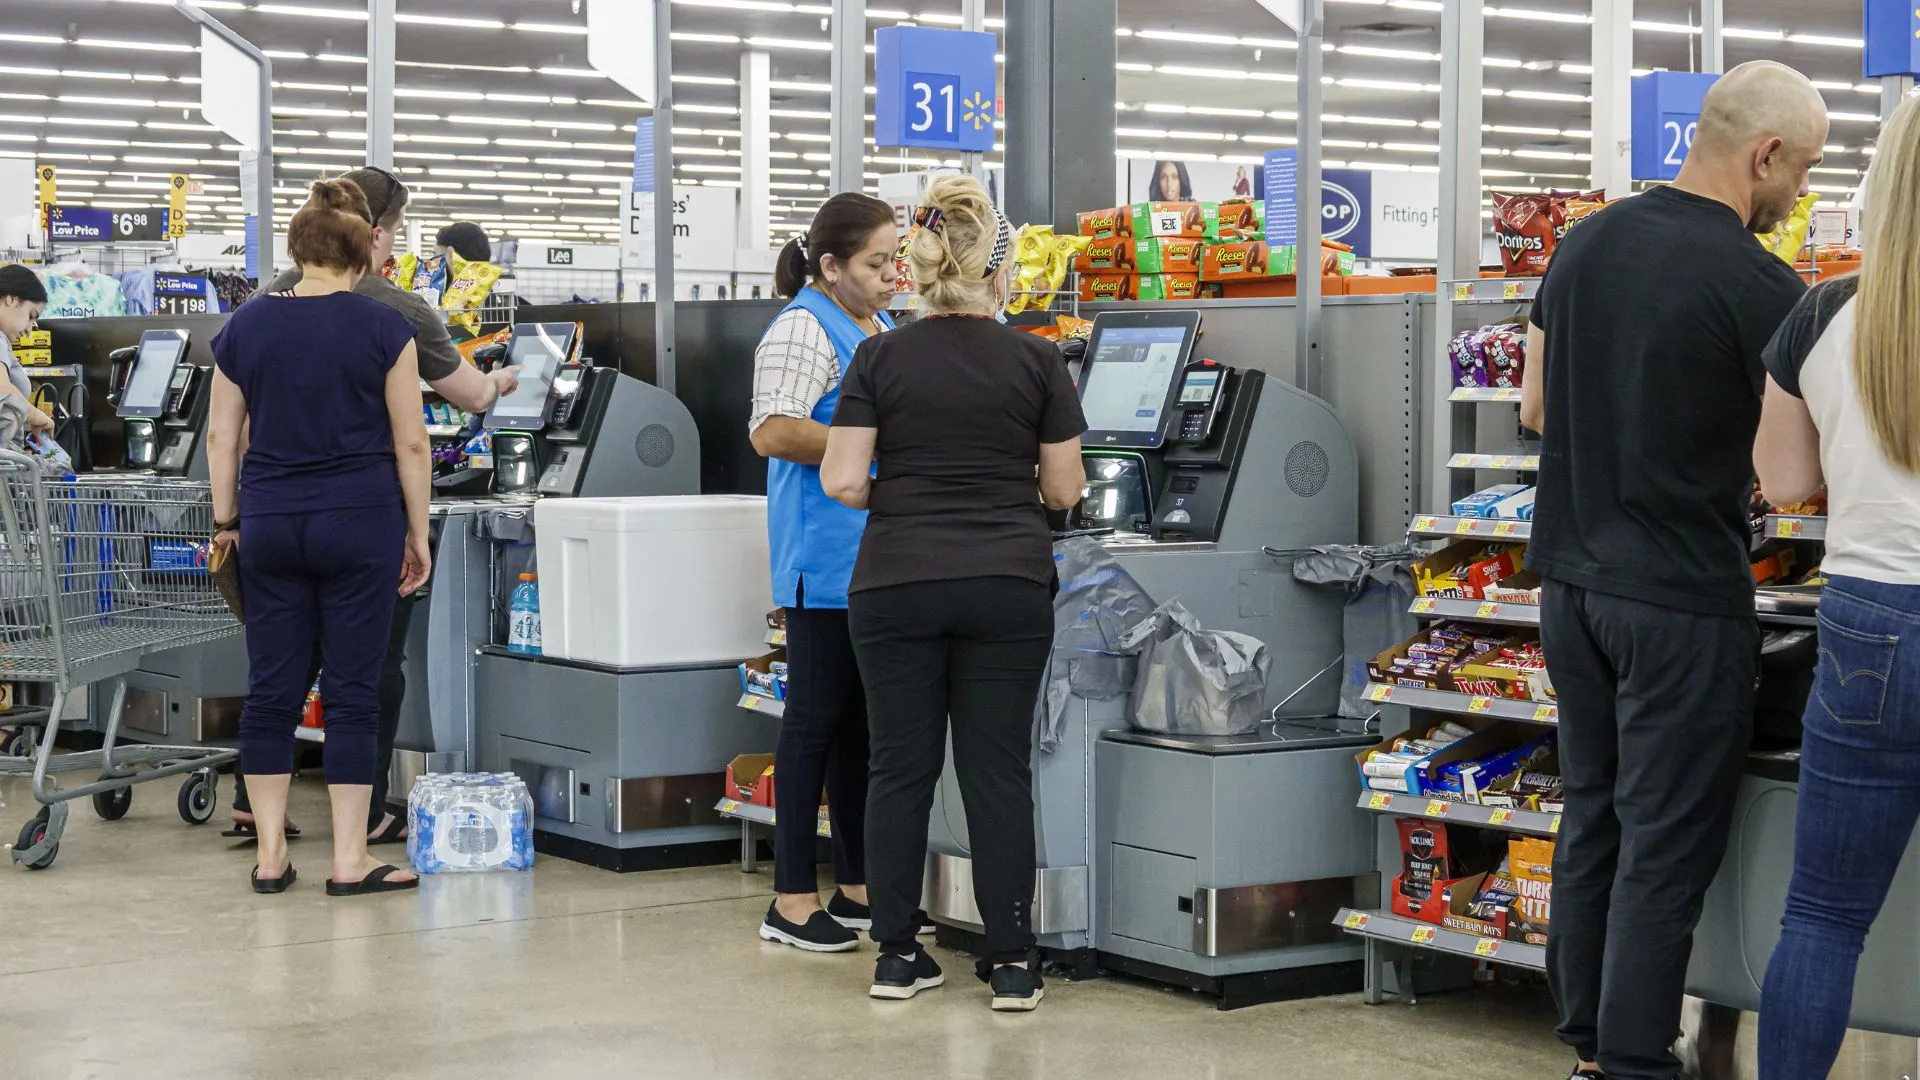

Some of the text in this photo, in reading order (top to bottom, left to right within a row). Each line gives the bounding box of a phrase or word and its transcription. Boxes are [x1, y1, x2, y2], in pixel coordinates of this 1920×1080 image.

[911, 82, 954, 133] 31
[173, 210, 183, 220] D
[1383, 205, 1428, 226] Fitting
[53, 226, 99, 235] Low Price
[170, 224, 184, 235] 23
[1496, 231, 1543, 250] Doritos
[550, 250, 571, 263] Lee
[168, 281, 198, 290] Low Price
[61, 307, 95, 317] MOM
[1751, 515, 1767, 527] TRA
[1515, 877, 1552, 900] TURK
[1443, 917, 1502, 937] SWEET BABY RAY'S
